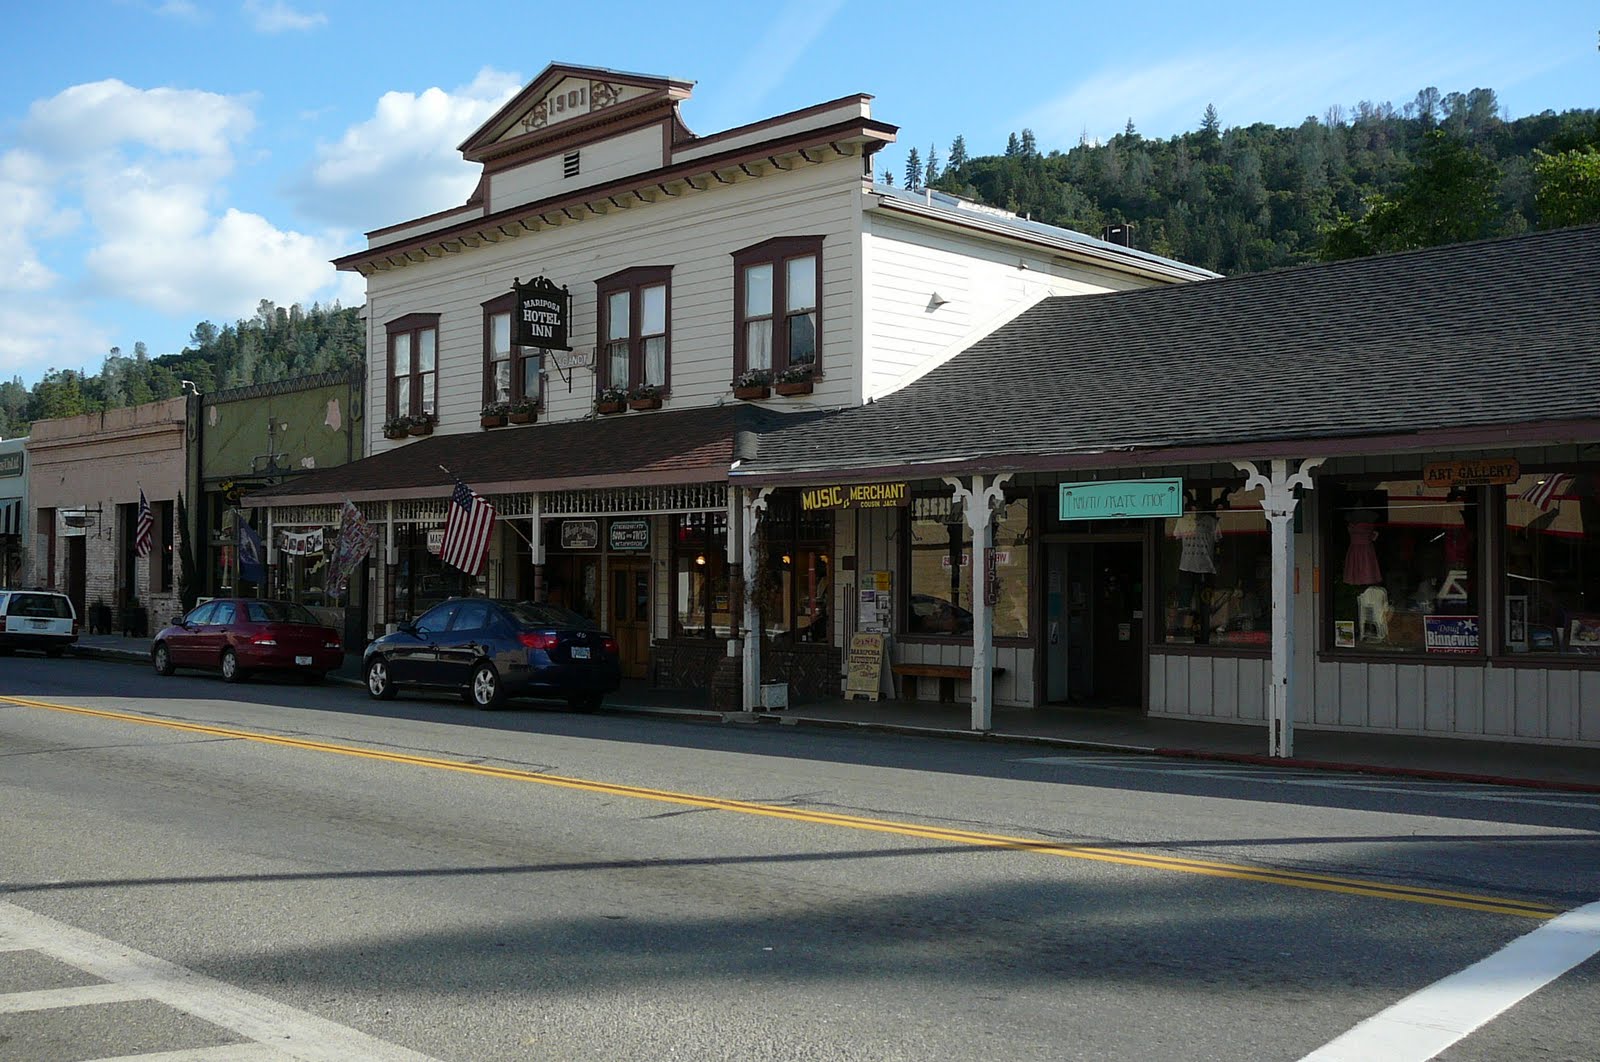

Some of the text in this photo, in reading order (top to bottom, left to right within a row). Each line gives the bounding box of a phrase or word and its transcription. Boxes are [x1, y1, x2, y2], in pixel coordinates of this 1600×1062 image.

[548, 87, 587, 117] 1901
[523, 299, 561, 314] MARIPOSA
[523, 309, 561, 326] HOTEL
[531, 323, 553, 338] INN
[1429, 464, 1512, 480] ART GALLERY
[802, 484, 906, 511] MUSIC MERCHANT
[1104, 494, 1137, 509] SKATE
[1141, 493, 1167, 507] SHOP
[987, 549, 996, 605] MUSIC
[1437, 624, 1460, 634] Doug
[1427, 630, 1479, 647] Binnewies
